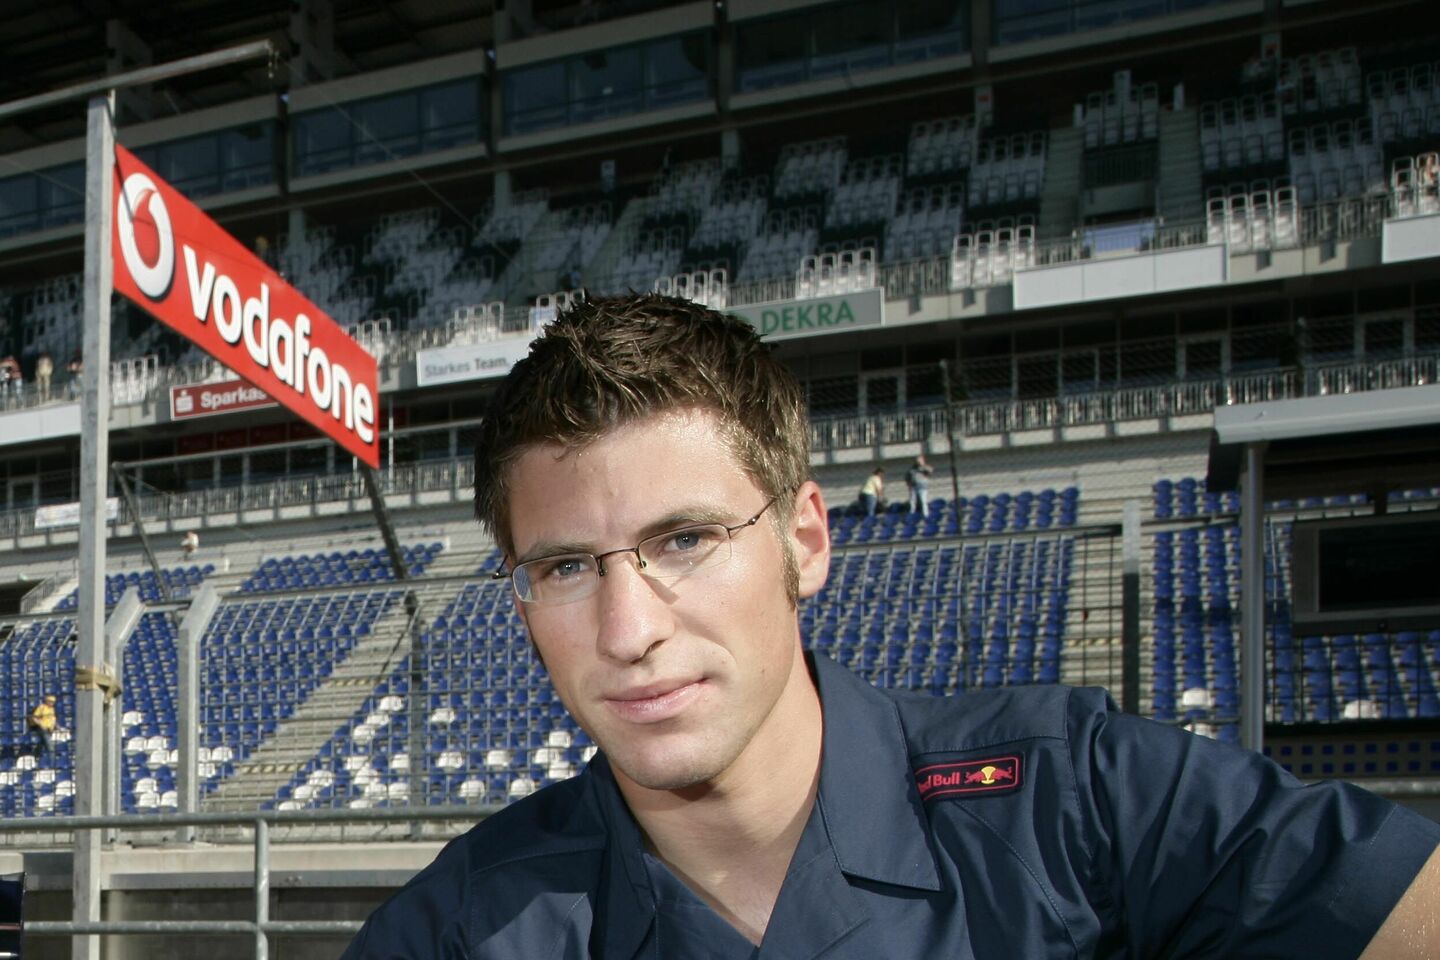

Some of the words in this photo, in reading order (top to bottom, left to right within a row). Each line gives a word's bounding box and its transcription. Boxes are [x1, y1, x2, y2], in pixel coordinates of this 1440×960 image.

[761, 300, 856, 333] DEKRA
[182, 244, 374, 443] vodafone
[932, 771, 961, 787] Bull
